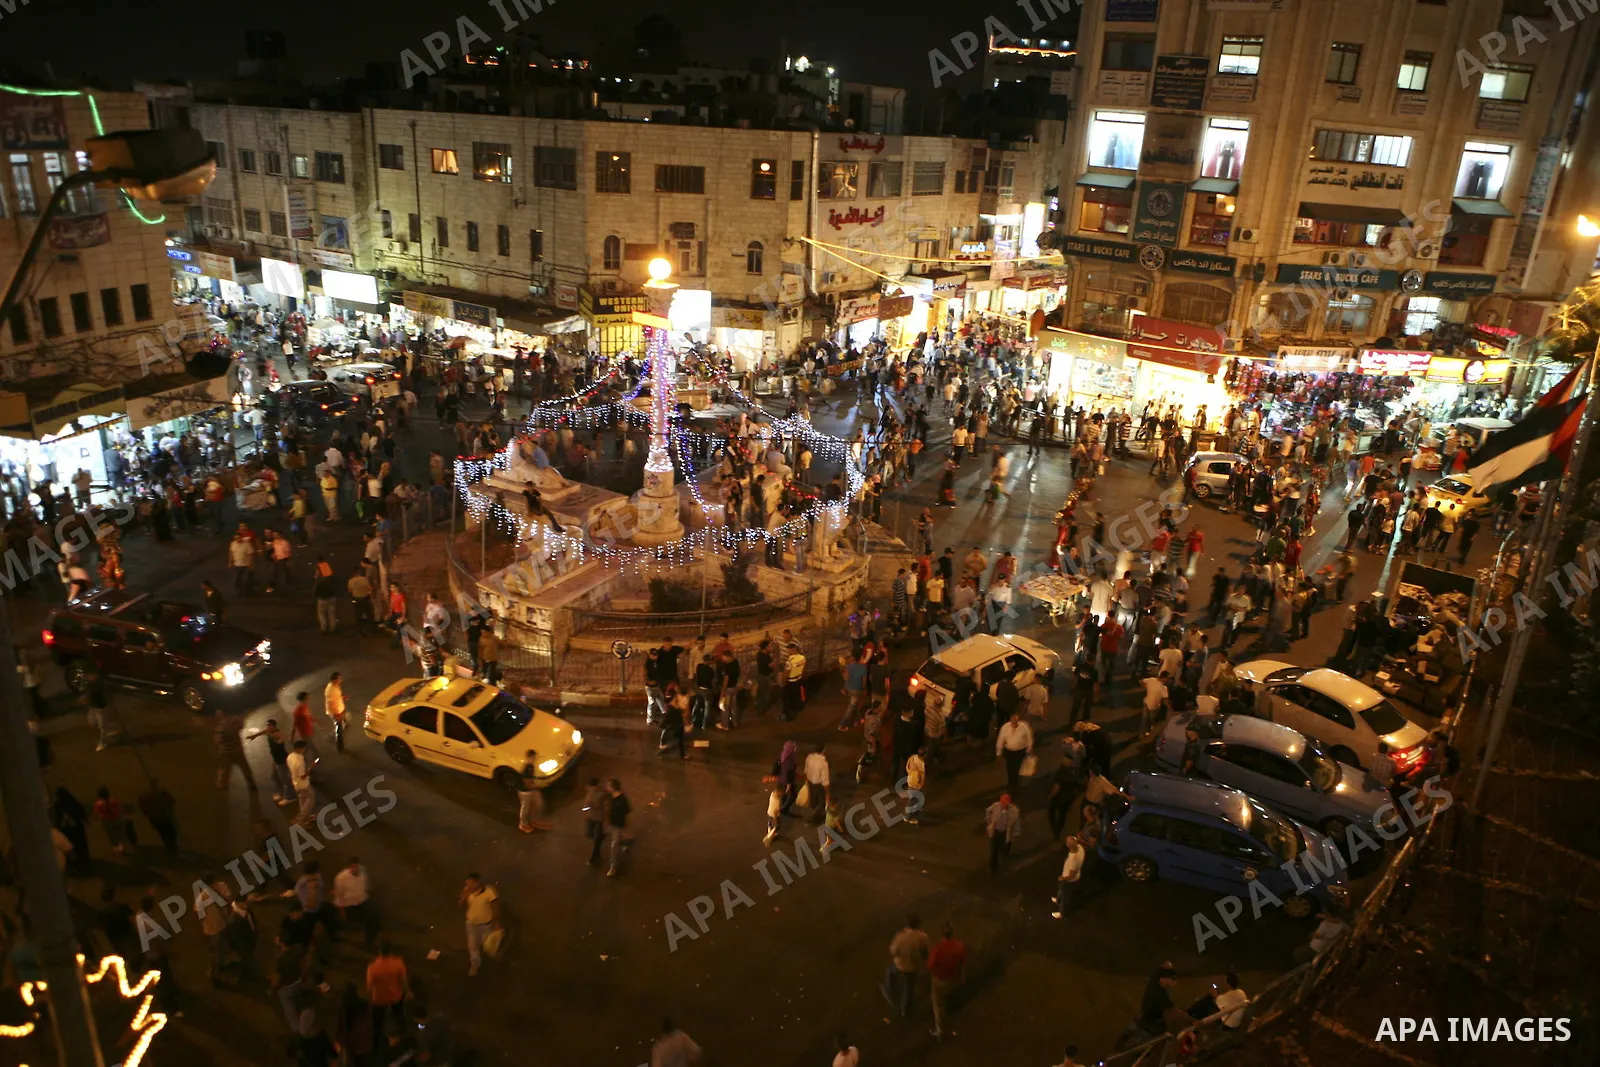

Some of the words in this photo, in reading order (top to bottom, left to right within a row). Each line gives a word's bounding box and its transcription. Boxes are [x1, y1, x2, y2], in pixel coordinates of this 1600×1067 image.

[1067, 242, 1085, 252] STARS
[1093, 245, 1113, 257] BUCKS
[1115, 248, 1131, 259] CAFE
[1300, 270, 1322, 281] STARS
[1335, 272, 1358, 283] BUCKS
[1361, 274, 1379, 284] CAFE
[599, 296, 644, 306] WESTERN
[613, 304, 644, 313] UNION
[1175, 333, 1219, 352] مجوهرات
